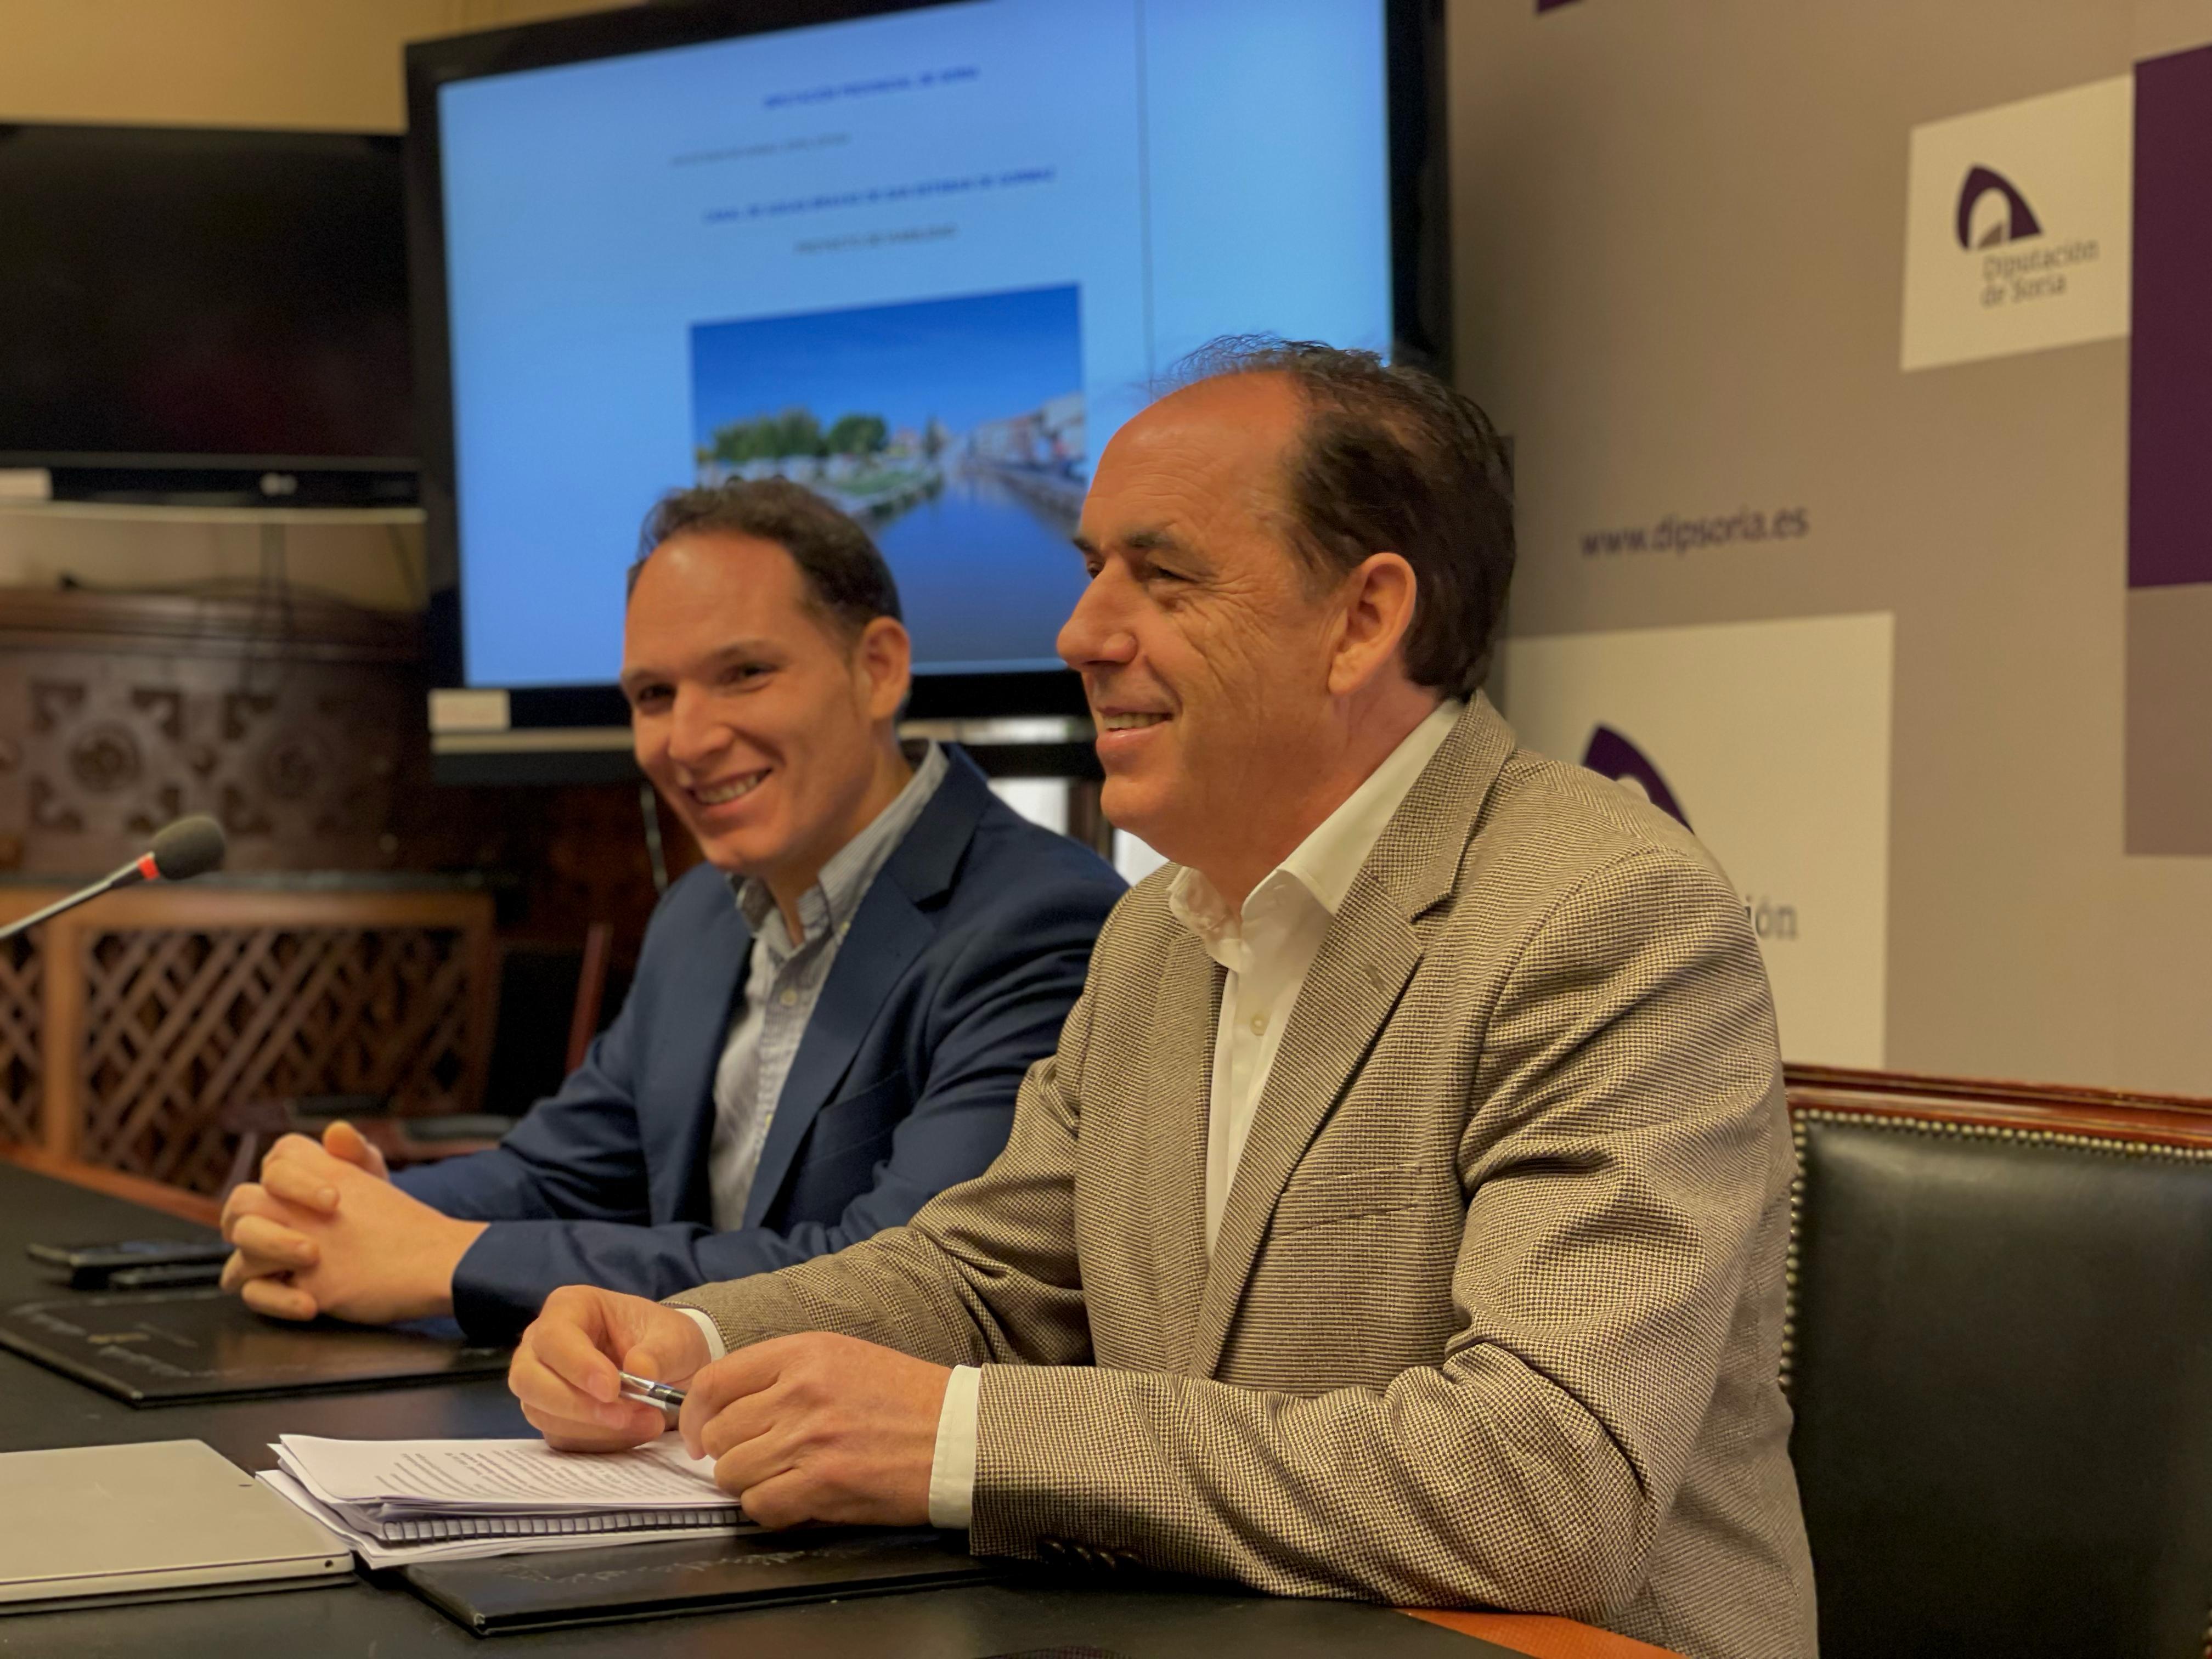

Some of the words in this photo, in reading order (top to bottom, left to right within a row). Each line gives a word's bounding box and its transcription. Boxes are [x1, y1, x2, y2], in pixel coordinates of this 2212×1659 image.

[1982, 239, 2098, 281] Diputación
[1982, 283, 2006, 307] de
[2012, 275, 2067, 303] Soria
[1582, 505, 1809, 557] www.dipsoria.es
